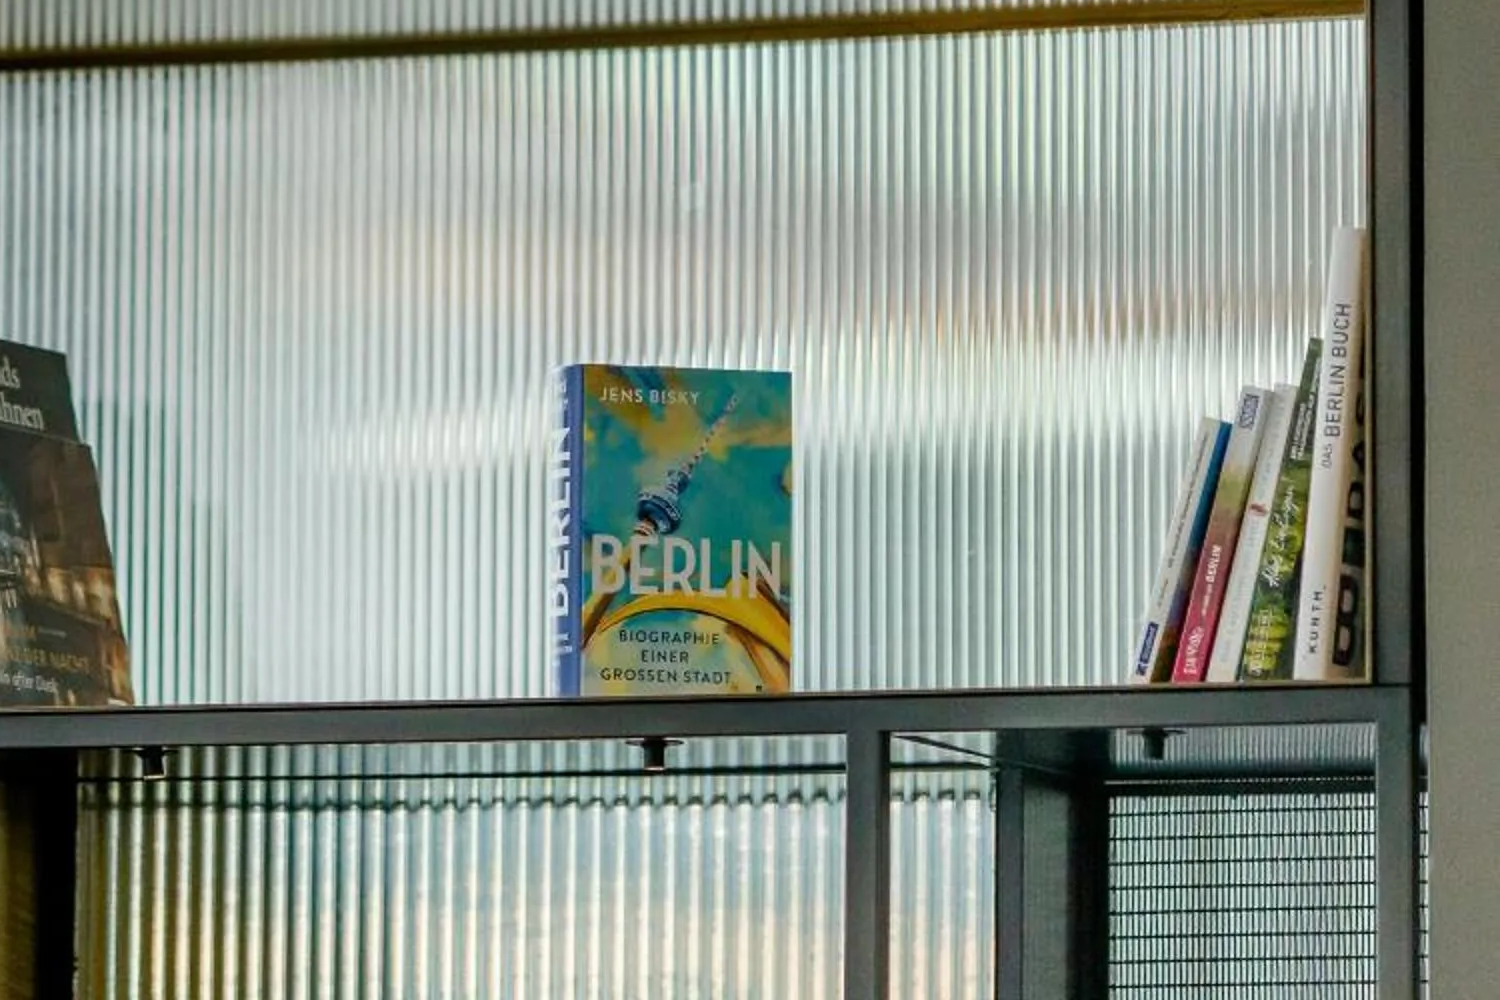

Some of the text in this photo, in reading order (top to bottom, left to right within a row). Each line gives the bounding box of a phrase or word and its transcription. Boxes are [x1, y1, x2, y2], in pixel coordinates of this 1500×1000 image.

[1331, 302, 1351, 358] BUCH
[599, 388, 700, 405] JENS BISKY
[1324, 364, 1346, 437] BERLIN
[548, 426, 572, 617] BERLIN
[591, 534, 782, 601] BERLIN
[619, 629, 720, 646] BIOGRAPHIE
[1307, 589, 1323, 654] KUNTH
[600, 667, 732, 685] GROSSEN STADT
[641, 650, 689, 664] EINER
